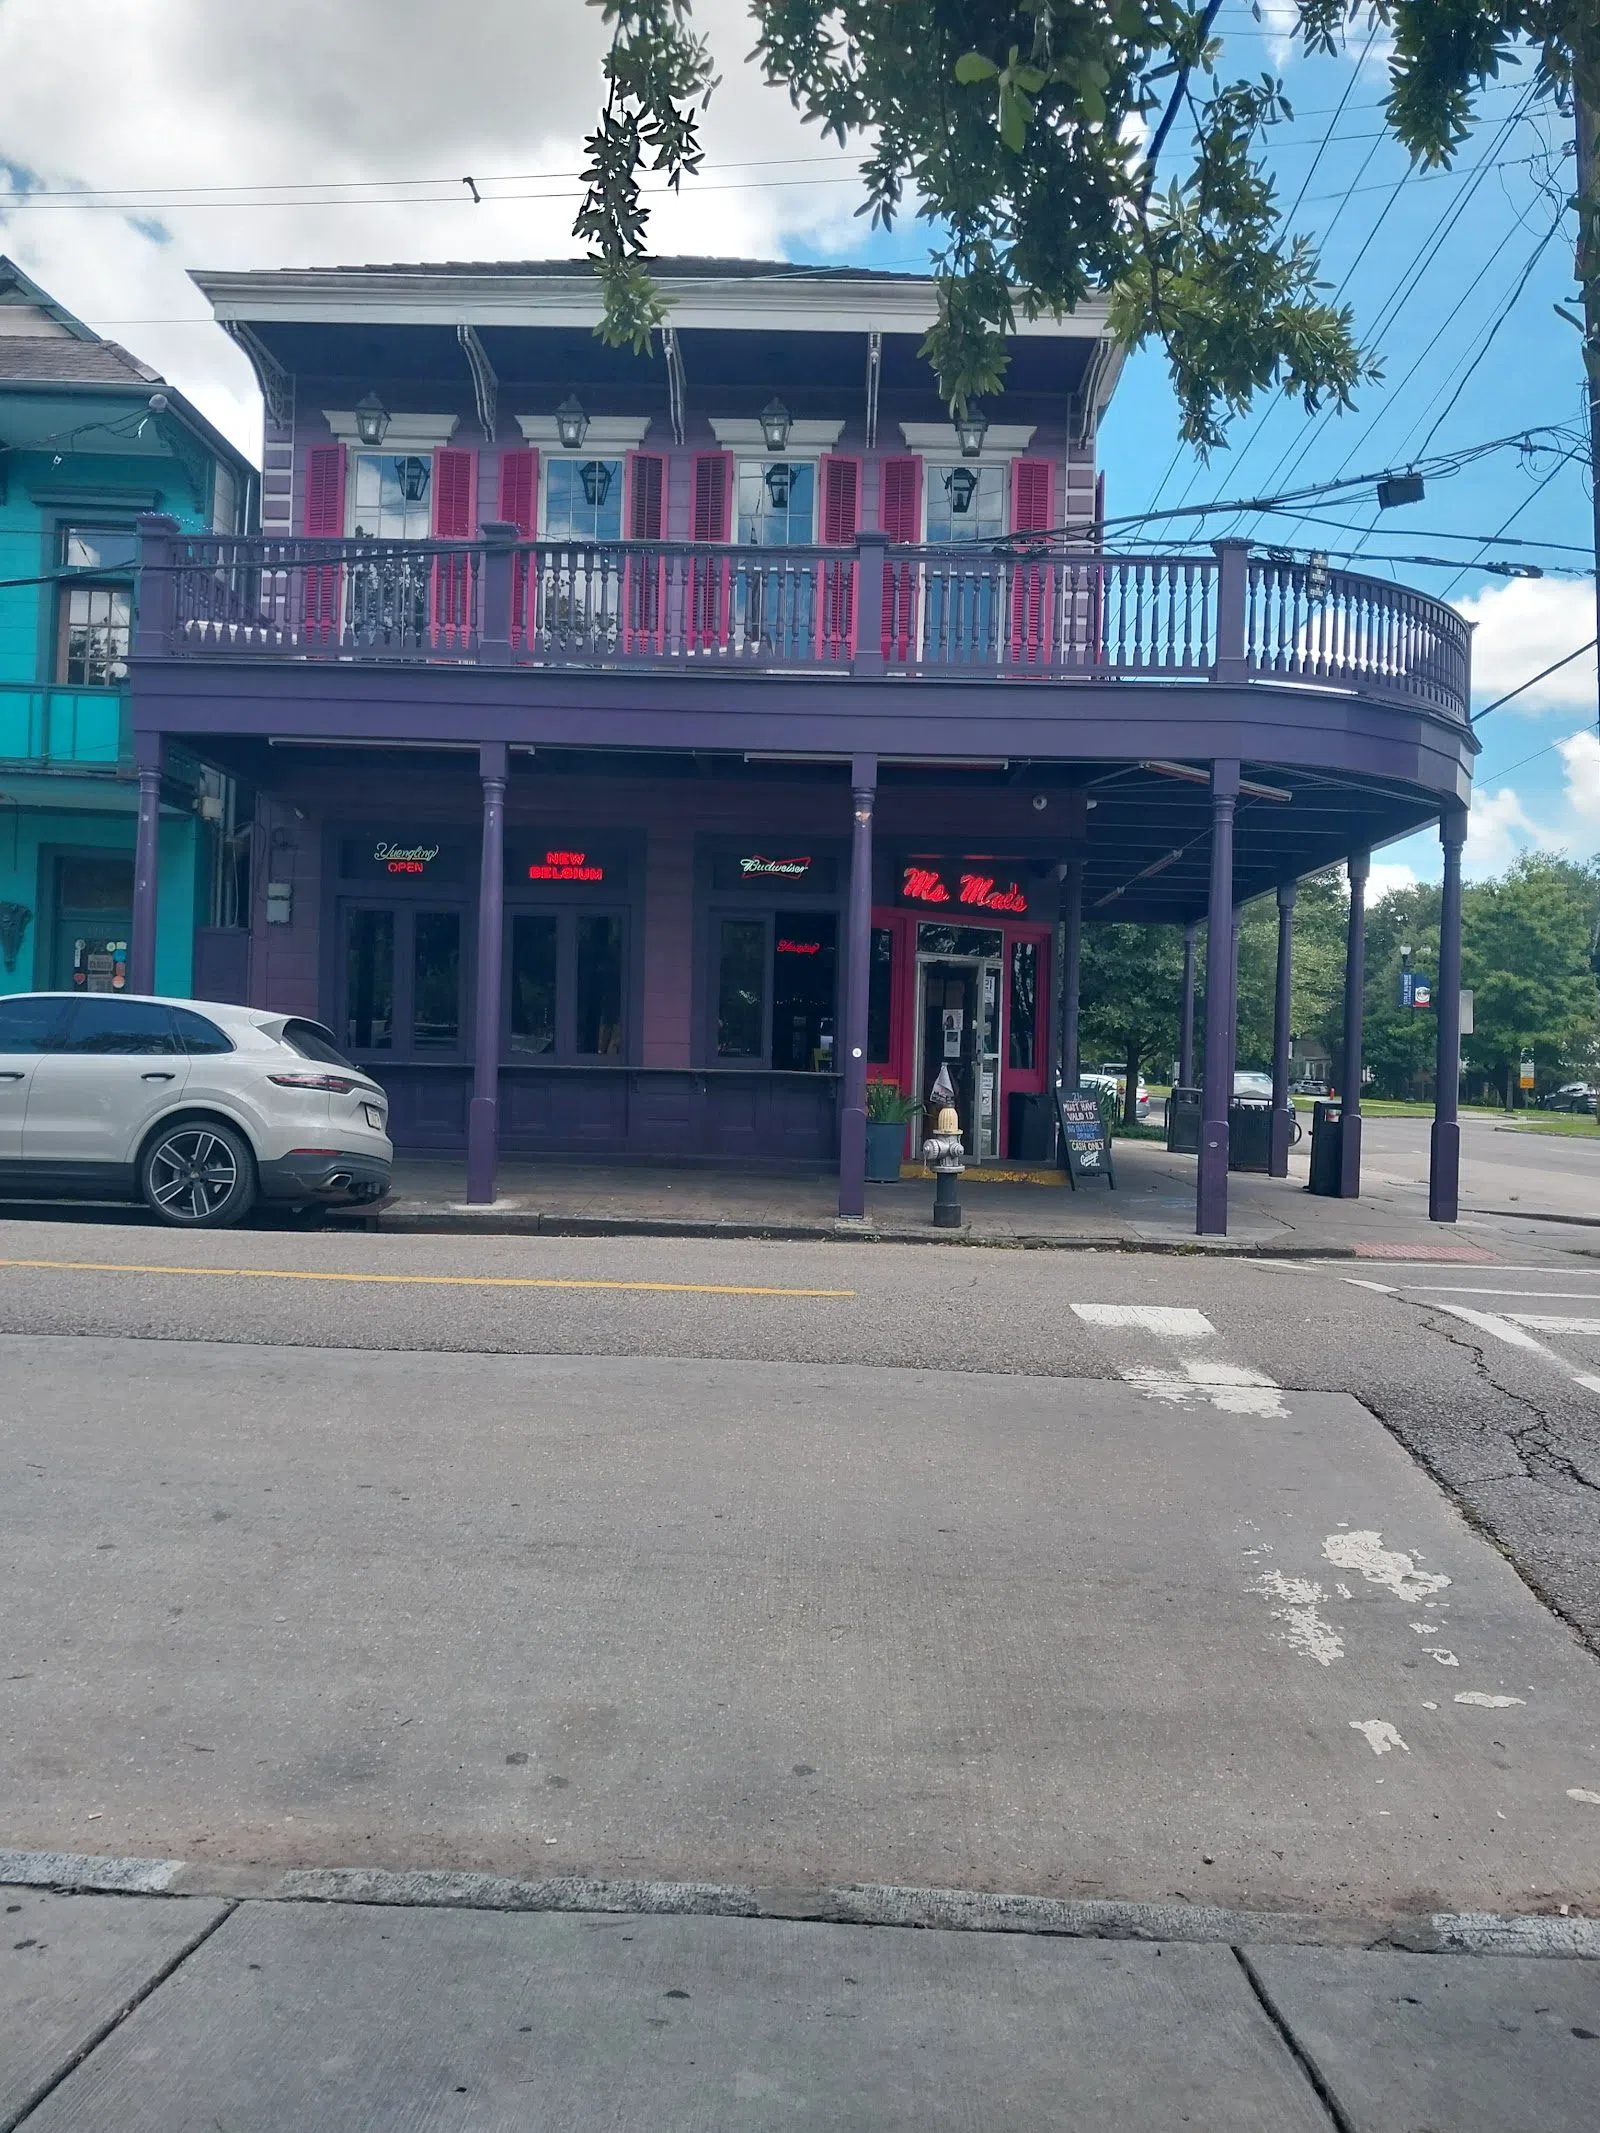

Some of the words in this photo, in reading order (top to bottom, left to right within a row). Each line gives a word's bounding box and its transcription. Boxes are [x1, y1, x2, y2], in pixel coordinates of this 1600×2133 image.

[374, 842, 439, 861] Yuengling
[547, 851, 585, 865] NEW
[388, 862, 424, 872] OPEN
[530, 866, 603, 880] BELGIUM
[740, 859, 809, 873] Budweiser
[904, 868, 950, 902] Ms
[1063, 1102, 1080, 1112] MUST
[1080, 1101, 1098, 1111] HAVE
[1067, 1112, 1084, 1121] VALID
[1072, 1141, 1087, 1151] CASH
[1087, 1141, 1105, 1151] ONLY
